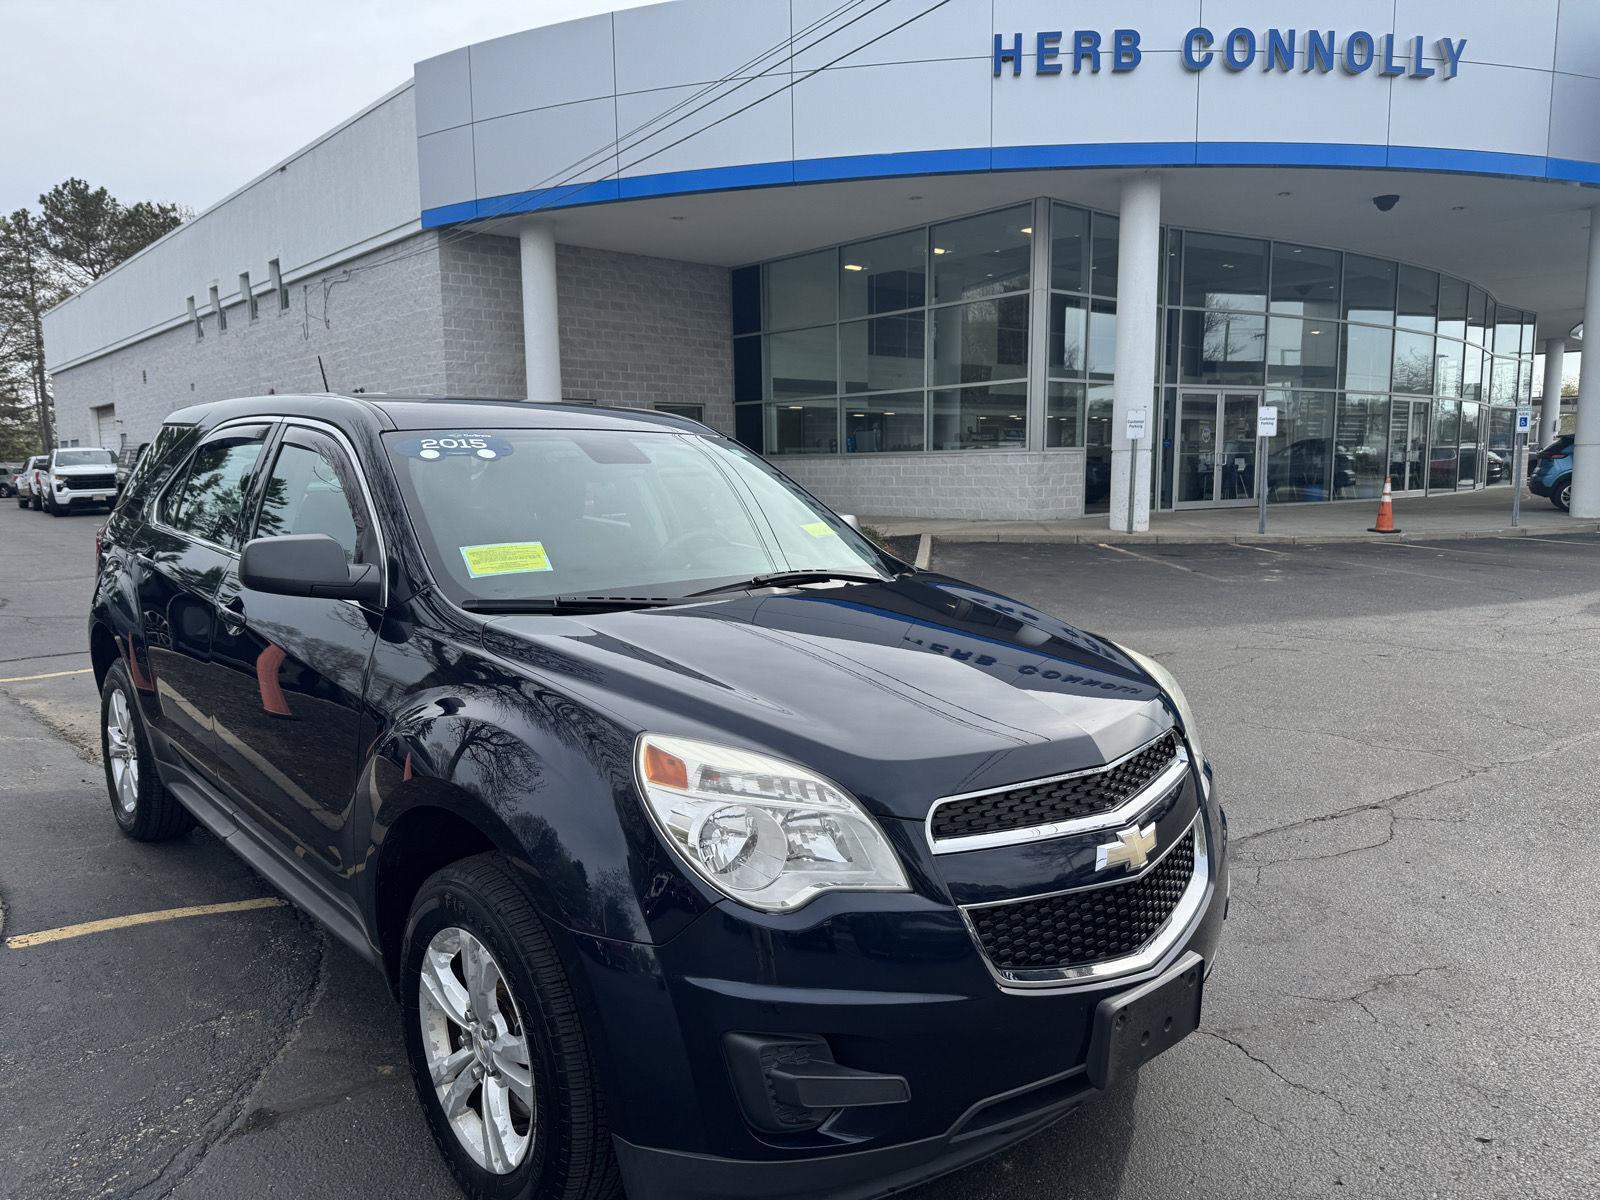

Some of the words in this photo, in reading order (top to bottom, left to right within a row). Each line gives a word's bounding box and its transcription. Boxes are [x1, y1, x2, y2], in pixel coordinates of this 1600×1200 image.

[993, 28, 1142, 78] HERB
[1181, 27, 1468, 81] CONNOLLY
[420, 438, 488, 449] 2015
